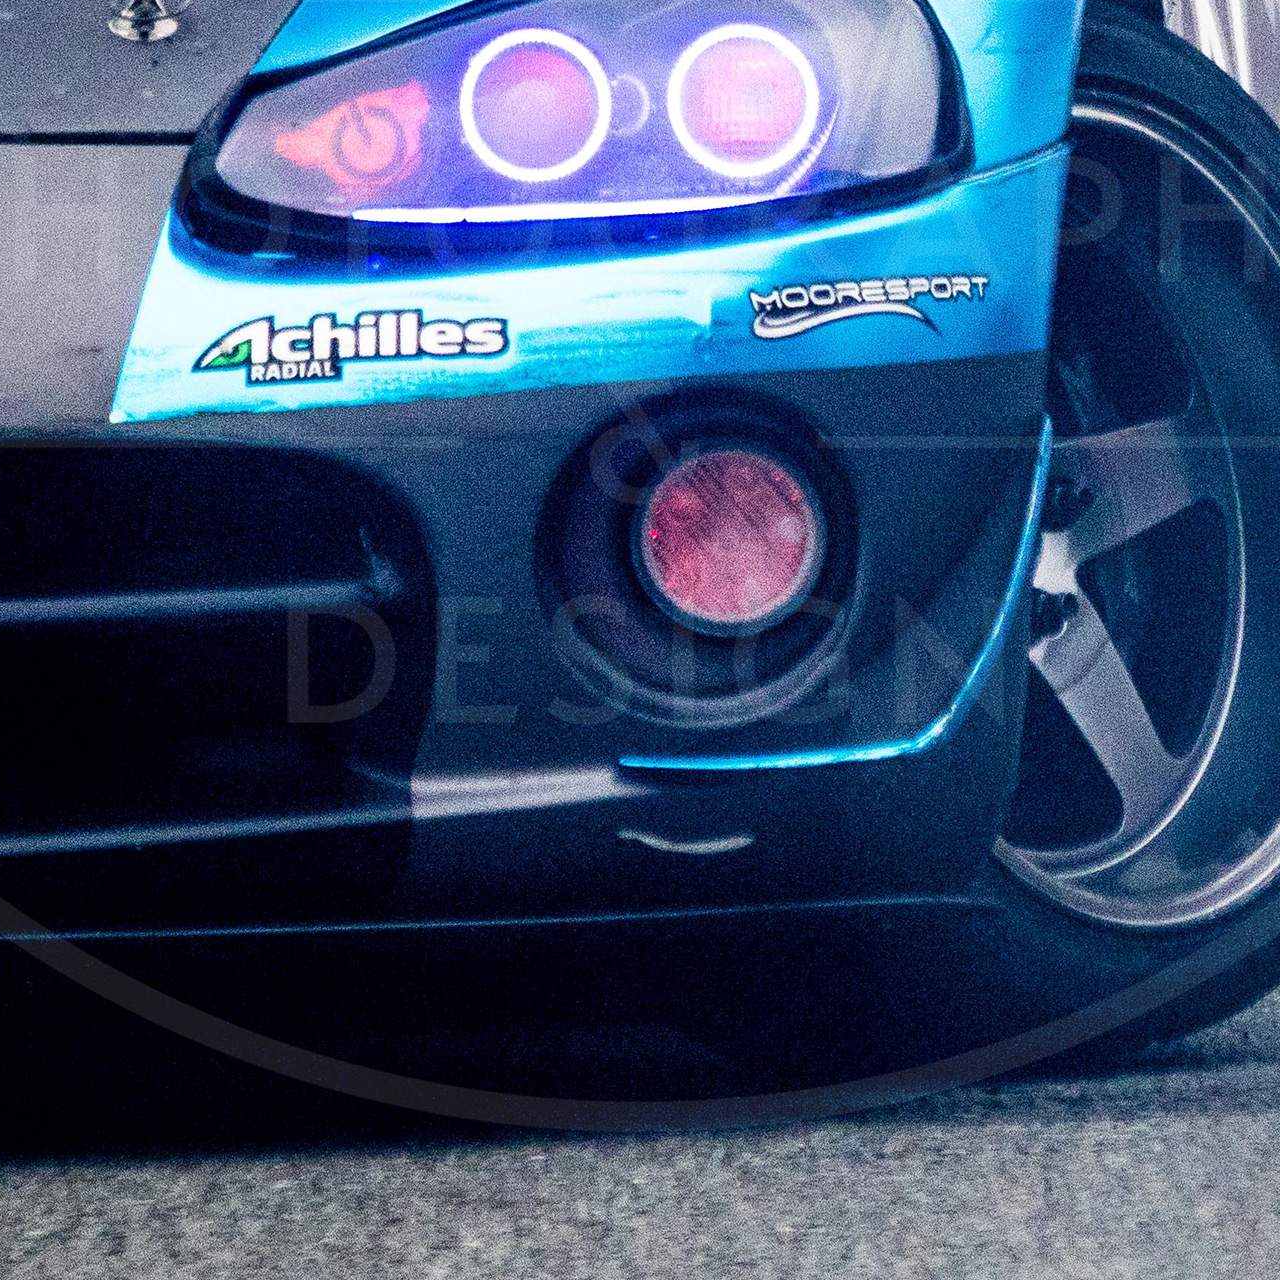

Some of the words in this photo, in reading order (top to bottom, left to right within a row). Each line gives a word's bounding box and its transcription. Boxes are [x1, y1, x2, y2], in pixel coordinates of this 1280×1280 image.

[749, 275, 989, 312] MOORESPORT
[198, 308, 507, 364] Achilles
[249, 360, 334, 382] RADIAL
